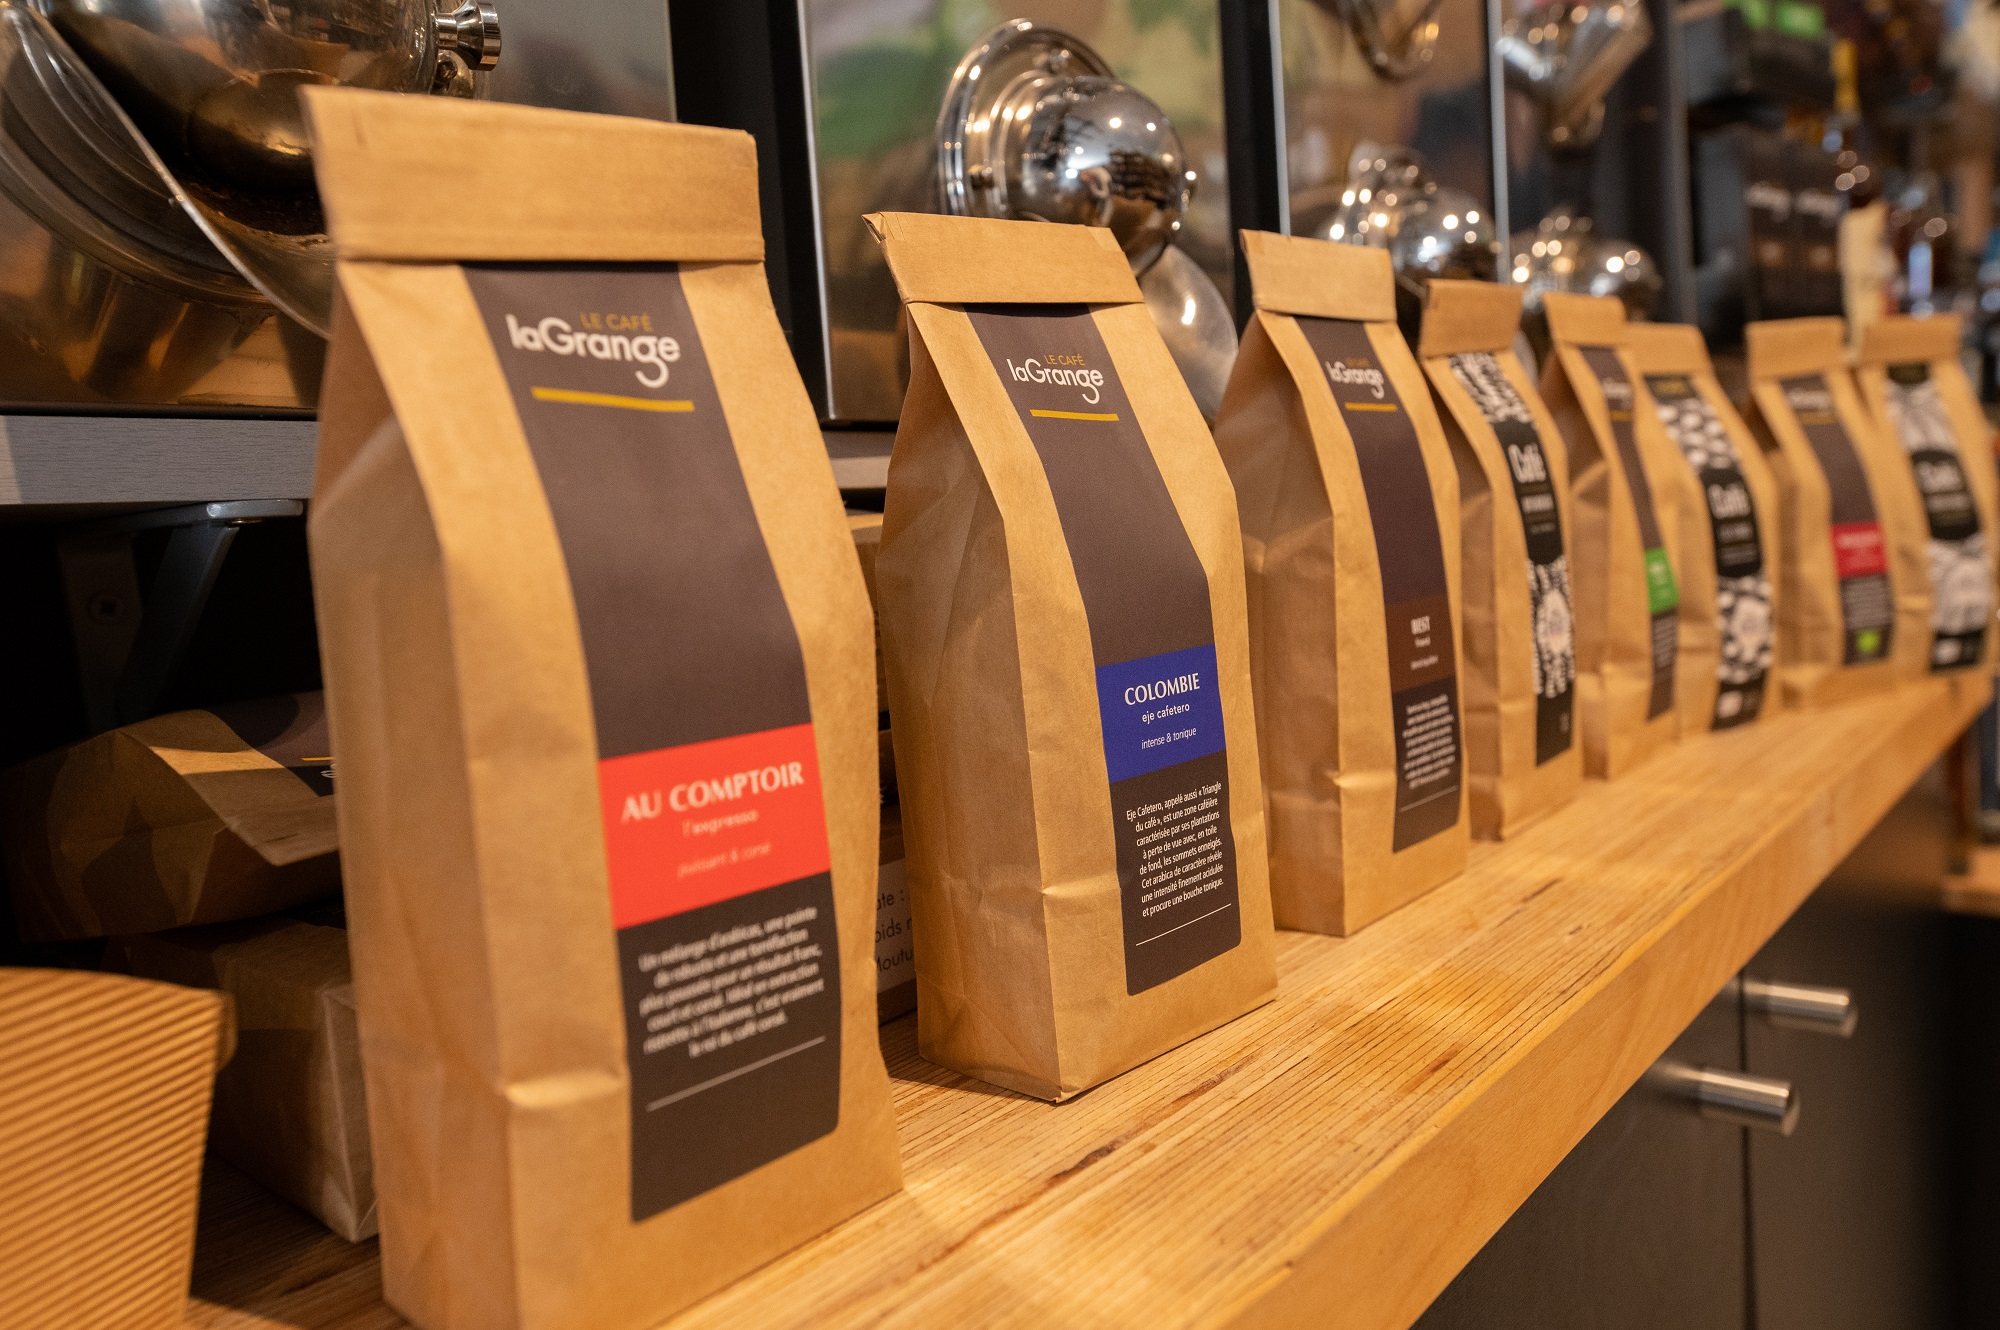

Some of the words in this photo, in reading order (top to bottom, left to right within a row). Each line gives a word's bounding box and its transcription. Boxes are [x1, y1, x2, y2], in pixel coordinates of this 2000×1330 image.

[580, 311, 599, 329] LE
[606, 312, 653, 332] CAFÉ
[506, 313, 681, 388] laGrange
[1044, 354, 1057, 365] LE
[1060, 352, 1085, 366] CAFÉ
[1006, 358, 1104, 404] laGrange
[1124, 672, 1200, 706] COLOMBIE
[1142, 711, 1154, 724] eje
[1157, 703, 1190, 719] cafetero
[1142, 736, 1165, 750] intense
[1166, 732, 1172, 742] &
[1173, 728, 1196, 740] tonique
[621, 789, 662, 825] AU
[669, 761, 805, 812] COMPTOIR
[1126, 810, 1136, 822] Eje
[1137, 802, 1164, 816] Cafetero,
[1164, 794, 1183, 809] appelé
[1184, 788, 1198, 802] aussi
[1136, 822, 1144, 832] du
[1163, 813, 1172, 822] est
[1172, 810, 1183, 820] une
[1184, 805, 1197, 816] zone
[1136, 828, 1170, 846] caractérisée
[1170, 824, 1180, 837] par
[1181, 822, 1190, 831] ses
[1190, 812, 1220, 830] plantations
[1142, 850, 1147, 860] à
[1148, 846, 1162, 860] perte
[1164, 841, 1171, 851] de
[1172, 838, 1182, 848] vue
[1198, 830, 1204, 839] en
[1205, 824, 1218, 836] toile
[1140, 864, 1147, 875] de
[1164, 856, 1172, 866] les
[1172, 847, 1198, 862] sommets
[1142, 878, 1152, 888] Cet
[1152, 870, 1173, 884] arabica
[1174, 866, 1181, 876] de
[1182, 858, 1206, 873] caractère
[1142, 892, 1153, 903] une
[1154, 880, 1177, 898] intensité
[1178, 872, 1202, 888] finement
[1142, 908, 1150, 917] et
[1150, 900, 1172, 917] procure
[1172, 896, 1182, 906] une
[1183, 886, 1202, 900] bouche
[1203, 878, 1224, 892] tonique.
[876, 918, 902, 943] oids
